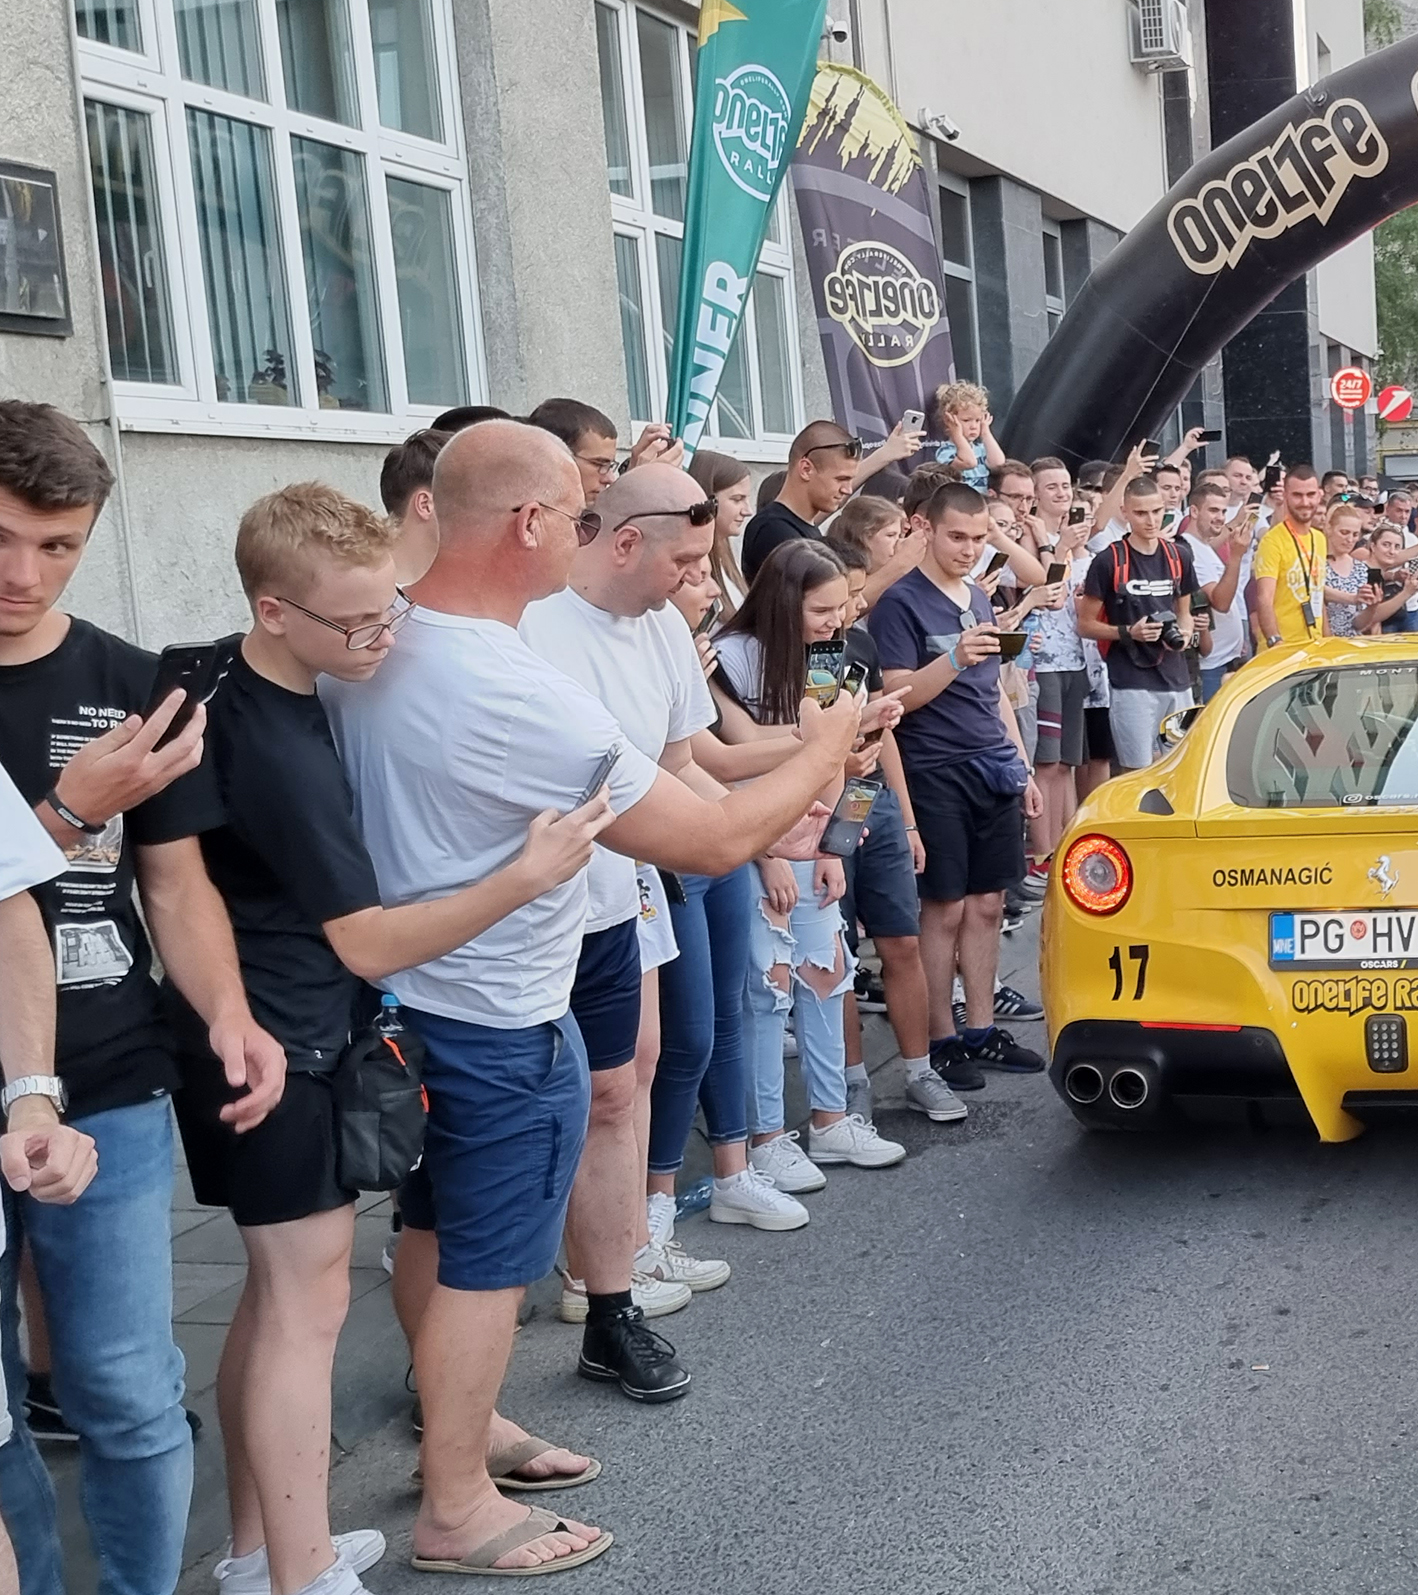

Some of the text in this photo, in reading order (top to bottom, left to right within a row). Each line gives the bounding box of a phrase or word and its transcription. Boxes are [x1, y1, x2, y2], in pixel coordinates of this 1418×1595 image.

[1340, 379, 1362, 389] 24/7
[79, 706, 97, 716] NO
[91, 718, 108, 729] TO
[1212, 862, 1333, 887] OSMANAGIĆ
[1300, 919, 1343, 954] PG
[1272, 938, 1294, 954] MNE
[1360, 960, 1398, 970] OSCARS
[1109, 945, 1149, 1001] 17
